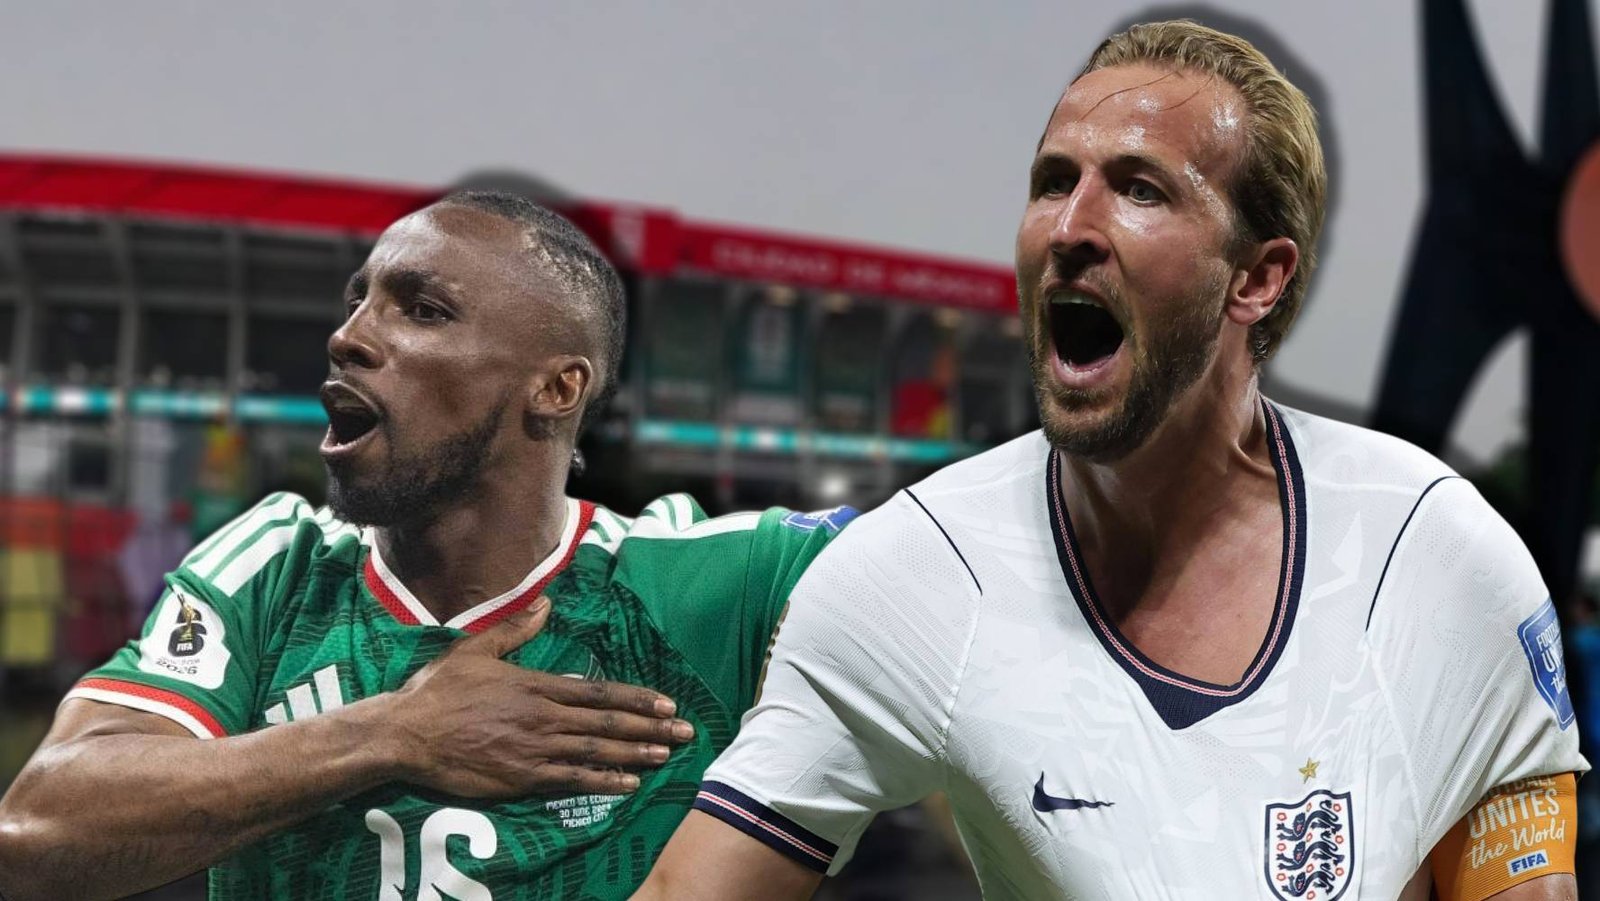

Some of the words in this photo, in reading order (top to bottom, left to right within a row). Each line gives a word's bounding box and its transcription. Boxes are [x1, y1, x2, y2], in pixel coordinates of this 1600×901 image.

[176, 642, 194, 652] FIFA
[563, 816, 592, 828] MEXICO
[593, 811, 610, 822] CITY
[572, 806, 590, 817] JUNE
[1467, 787, 1560, 839] UNITES
[1465, 839, 1508, 870] the
[1509, 817, 1566, 851] World
[1510, 852, 1547, 874] FIFA
